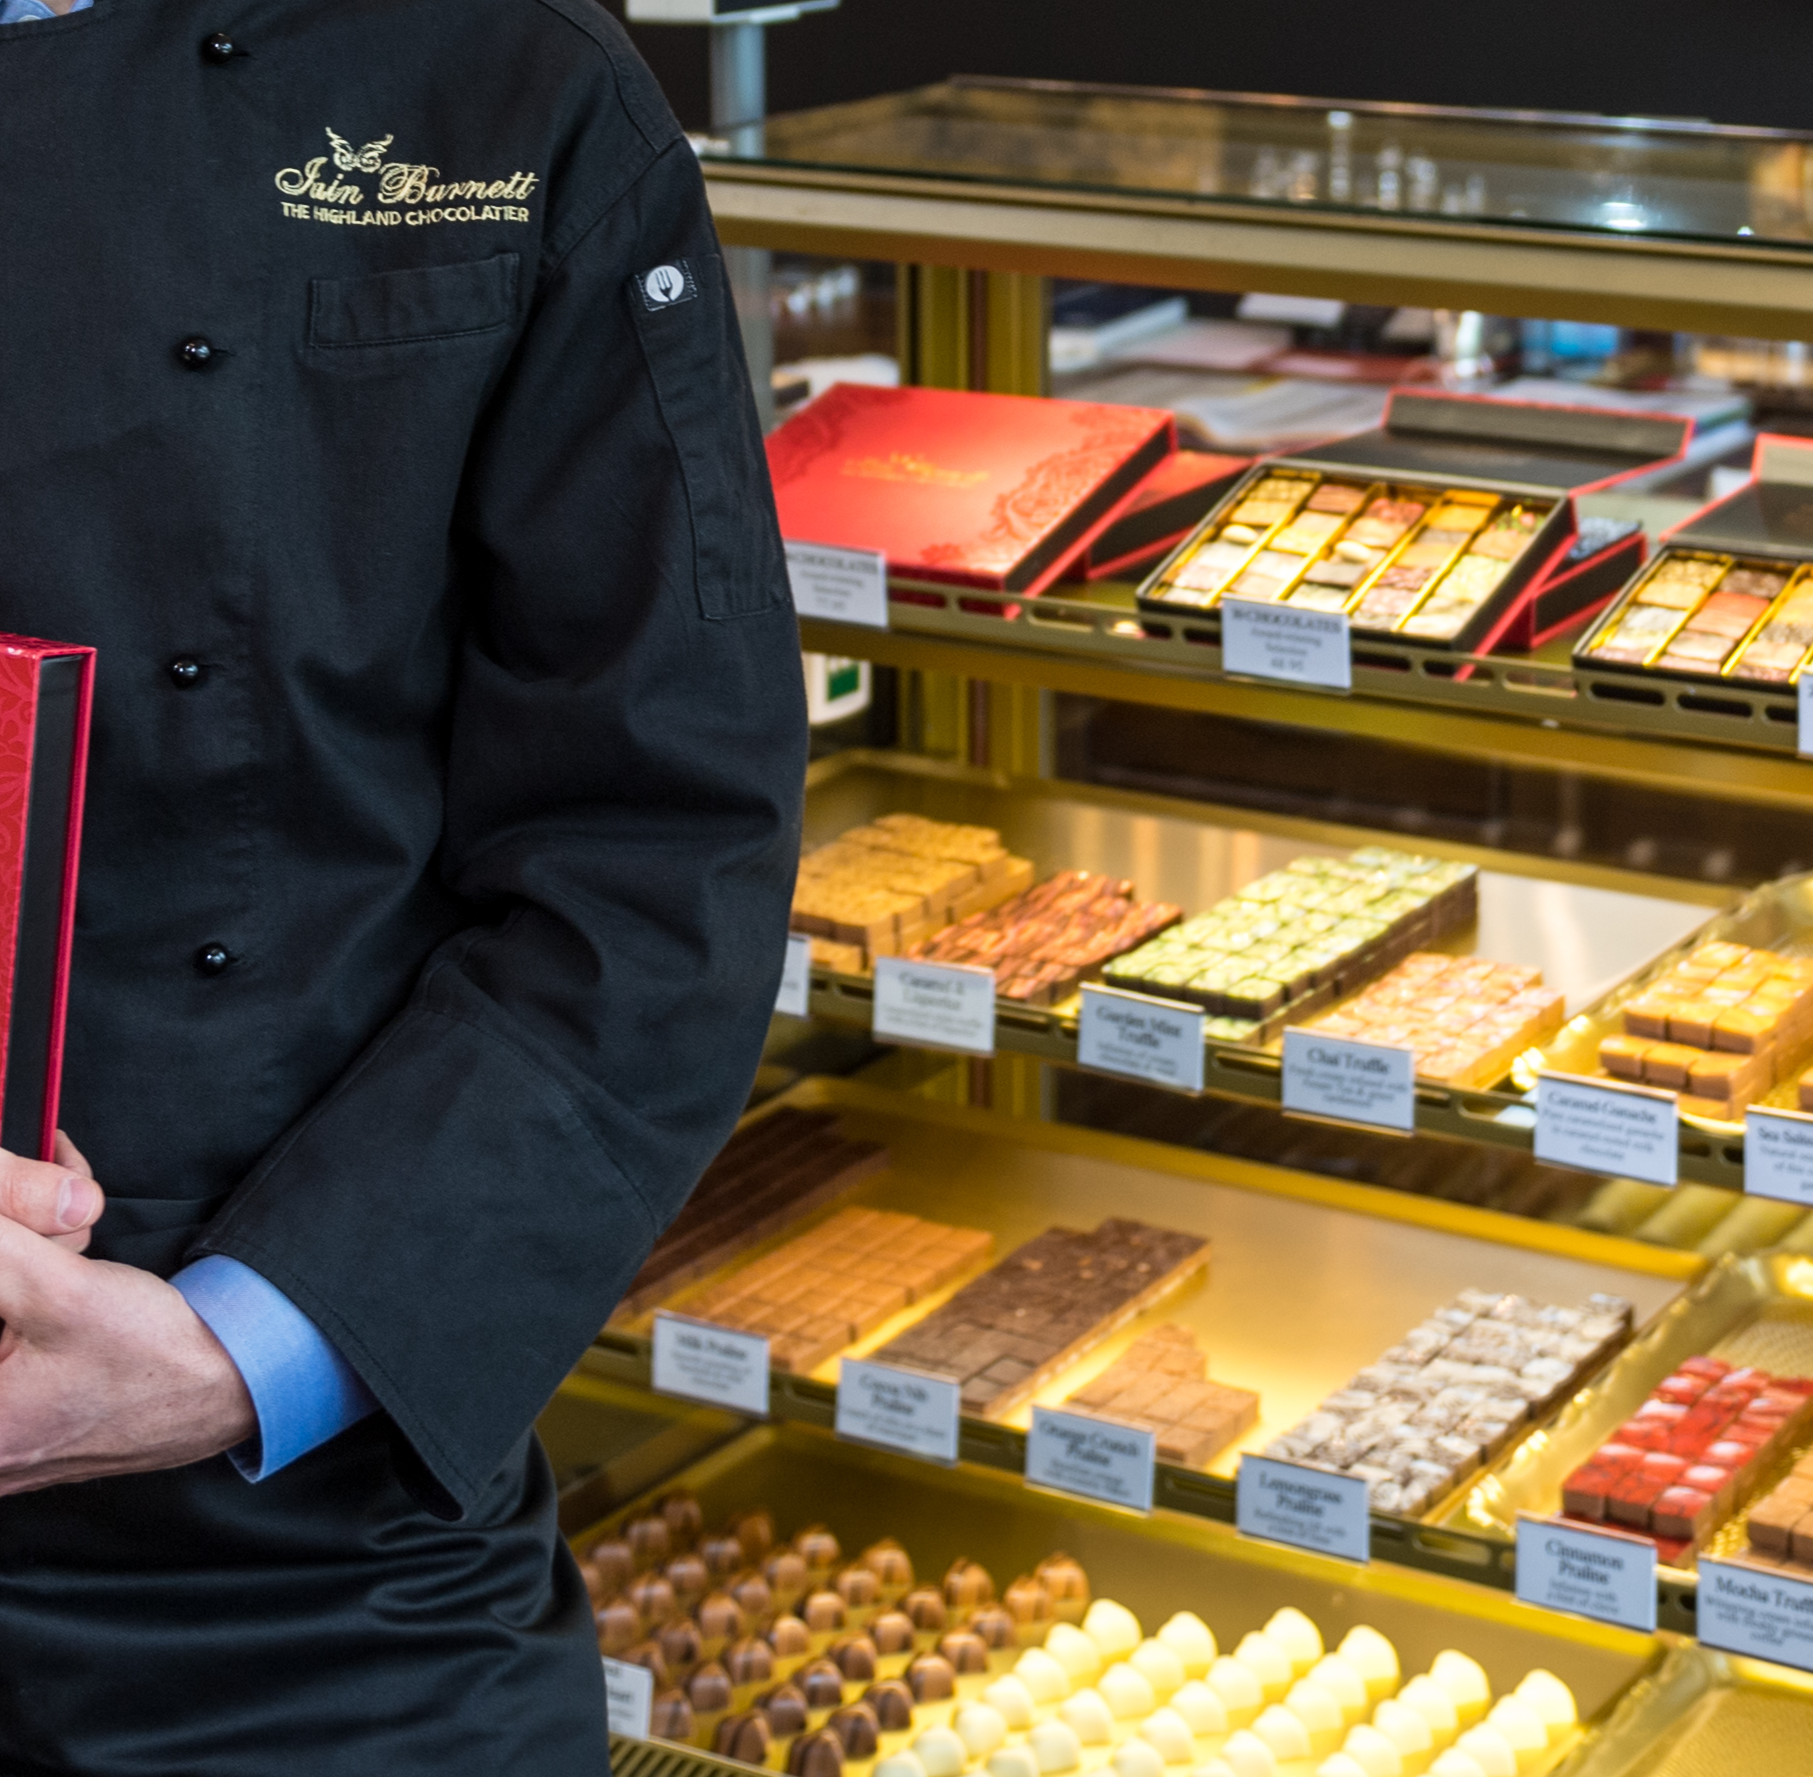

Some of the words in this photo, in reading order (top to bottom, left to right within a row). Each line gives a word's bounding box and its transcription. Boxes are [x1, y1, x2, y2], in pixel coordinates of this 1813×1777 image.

[275, 156, 364, 204] Iain
[378, 162, 540, 204] Burnett
[281, 202, 310, 219] THE
[313, 204, 401, 226] HIGHLAND
[405, 205, 529, 226] CHOCOLATIER
[1545, 1537, 1625, 1569] Cinnamon
[1559, 1560, 1610, 1584] Praline
[1716, 1575, 1769, 1604] Mocha
